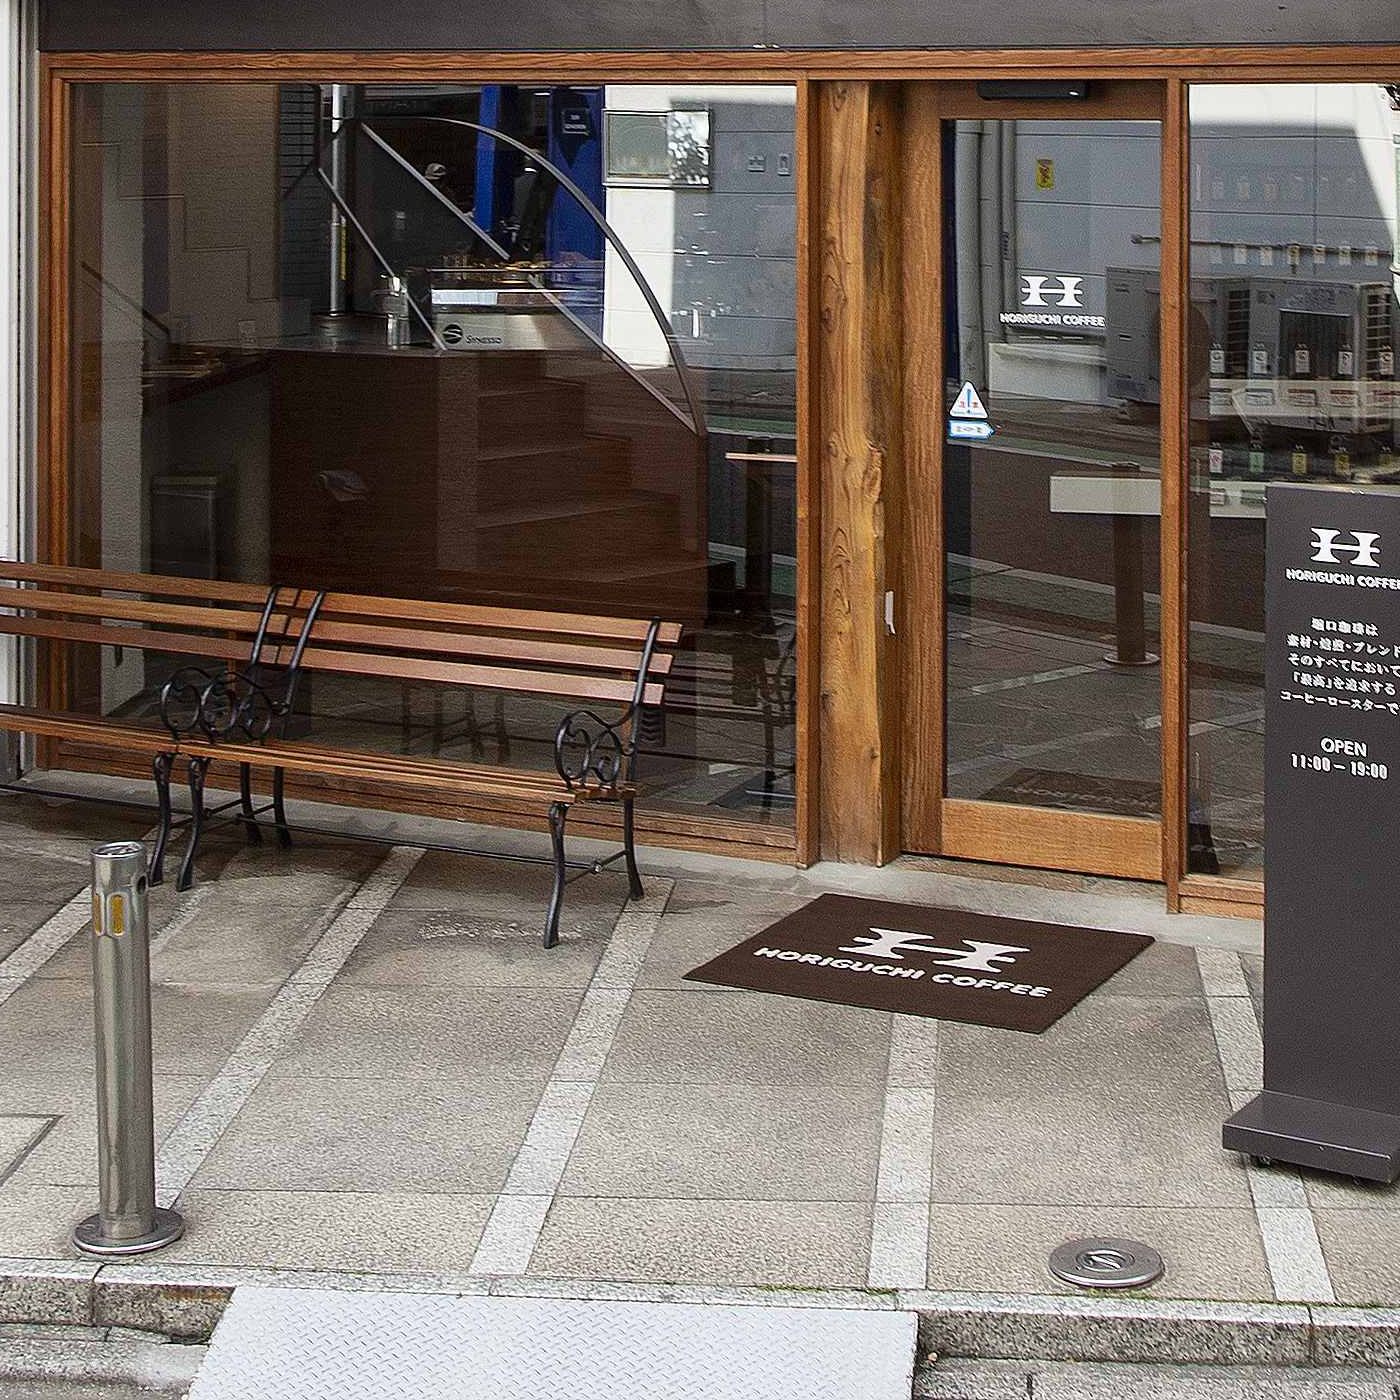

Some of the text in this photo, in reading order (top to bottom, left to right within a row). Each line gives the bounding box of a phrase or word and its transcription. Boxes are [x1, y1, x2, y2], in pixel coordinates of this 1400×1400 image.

[1000, 312, 1106, 327] HORIGUCHI COFFEE
[1286, 568, 1355, 586] HORIGUCHI
[1320, 737, 1367, 758] OPEN
[753, 946, 1054, 998] HORIGUCHI COFFEE
